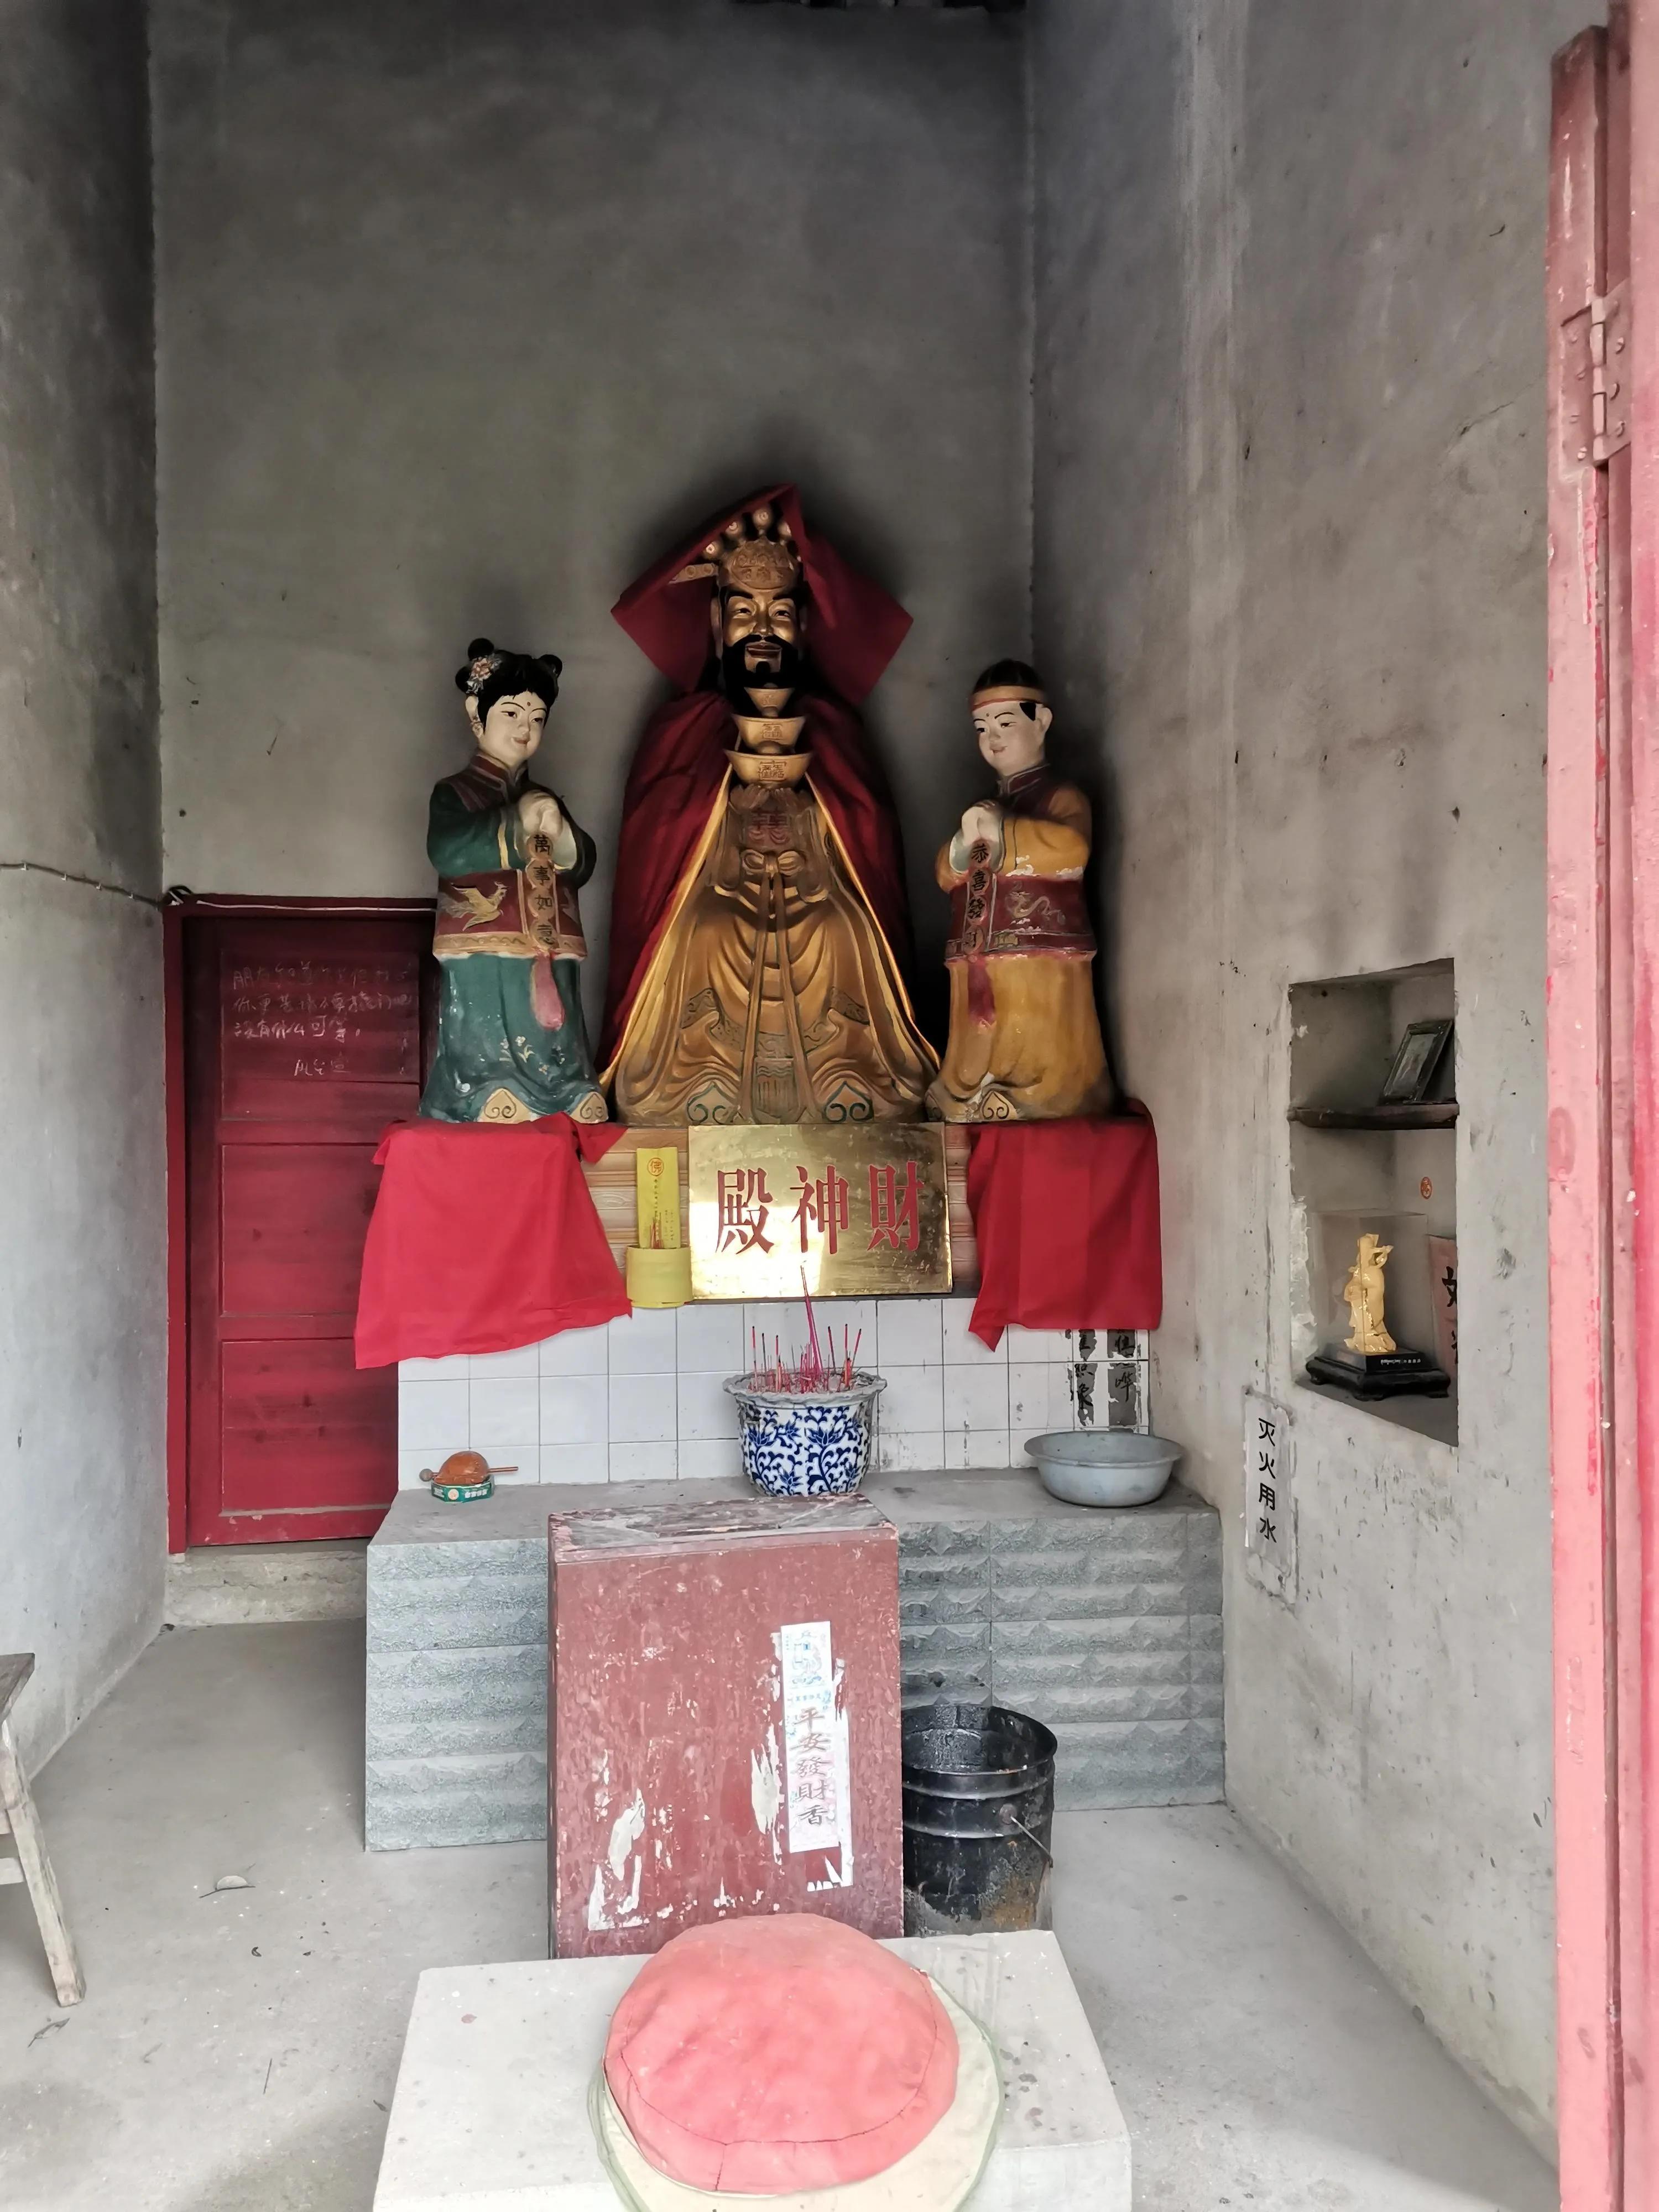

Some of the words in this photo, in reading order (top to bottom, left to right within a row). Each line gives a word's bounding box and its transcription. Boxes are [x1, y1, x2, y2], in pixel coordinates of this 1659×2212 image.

[1258, 1417, 1277, 1543] 灭火用水
[790, 1707, 831, 1825] 平安發財香
